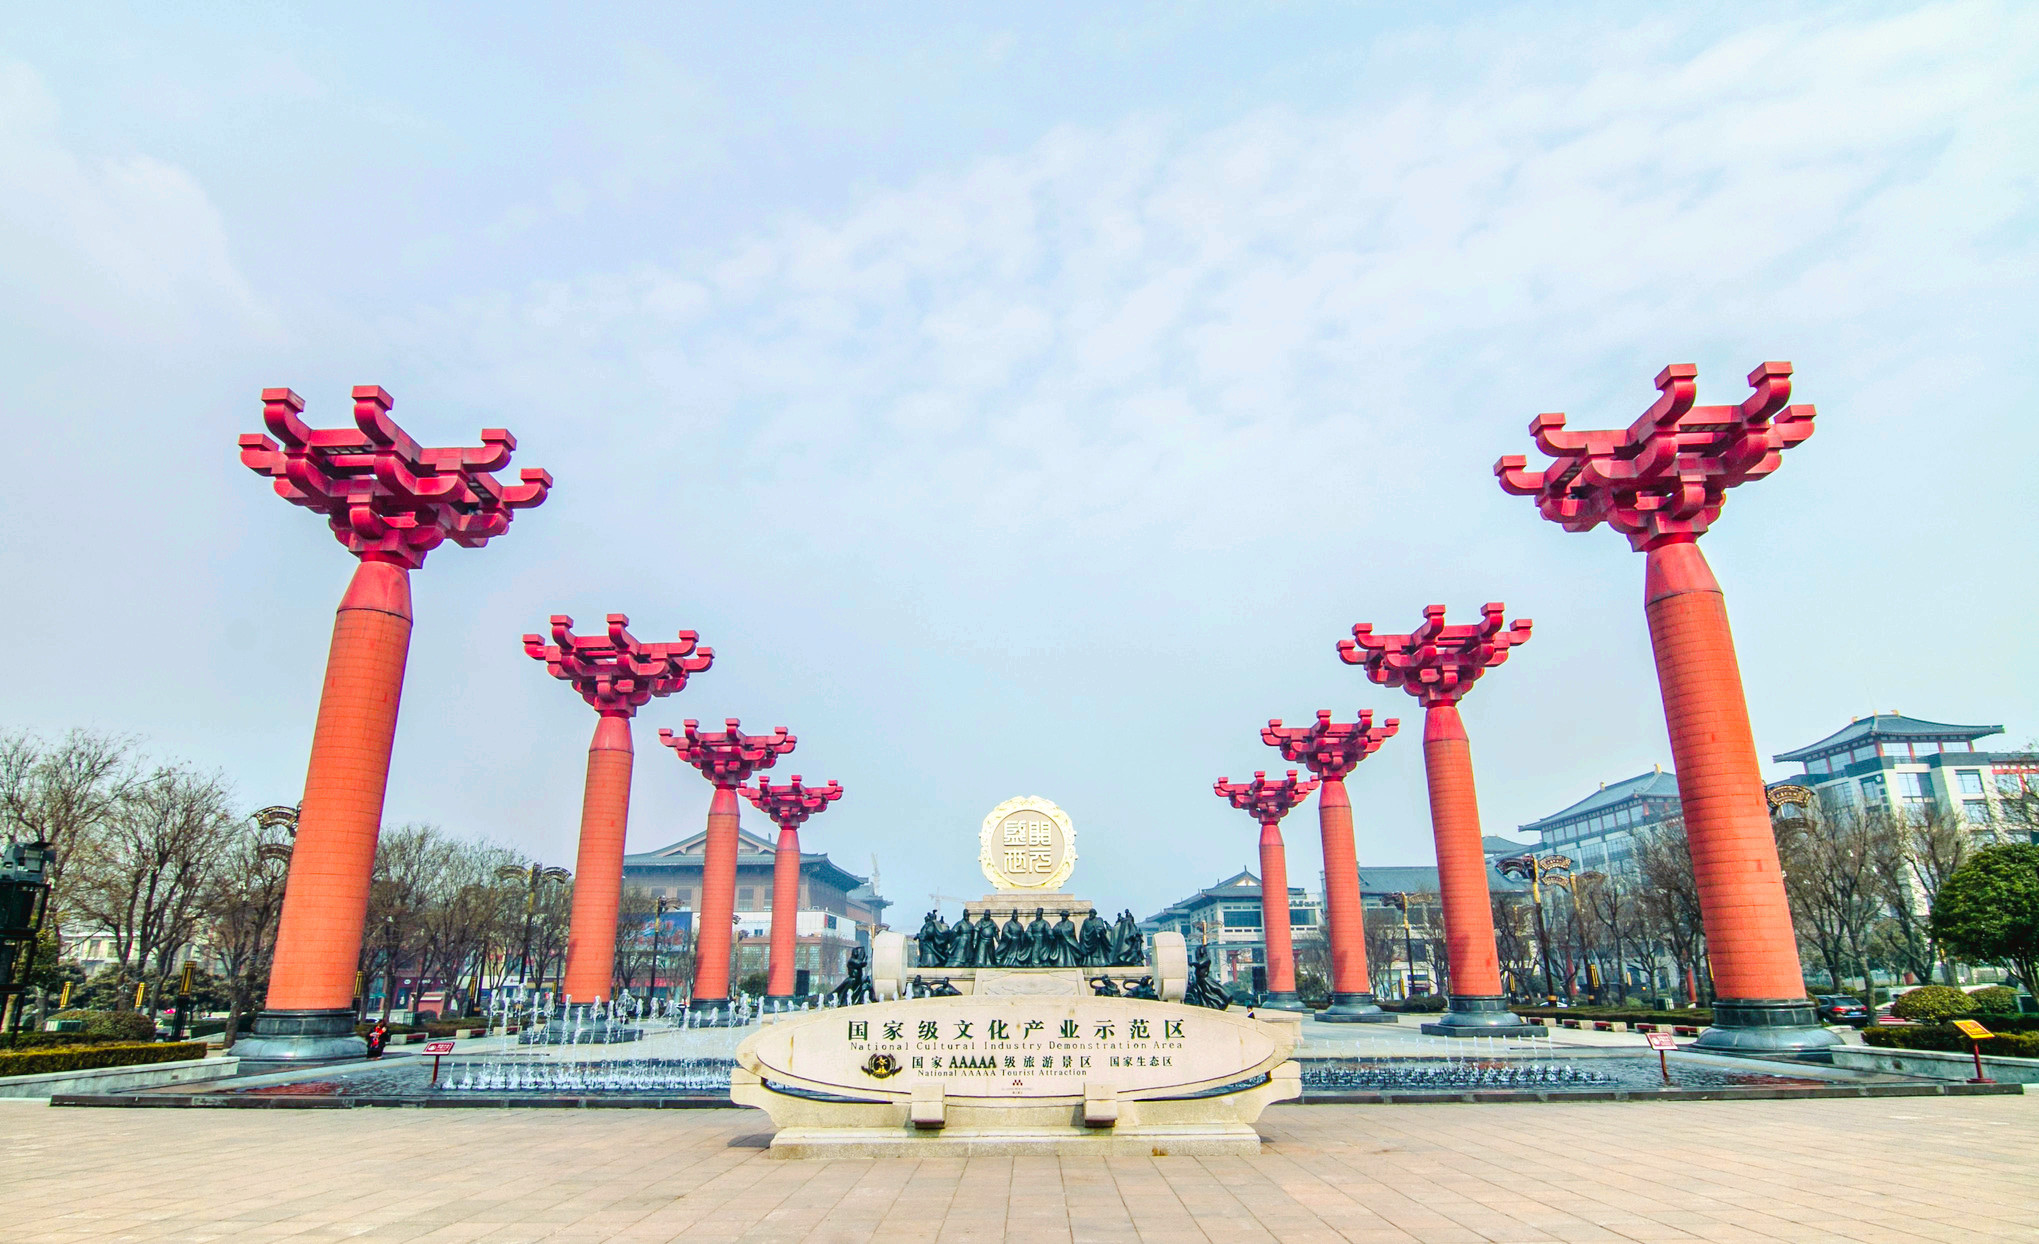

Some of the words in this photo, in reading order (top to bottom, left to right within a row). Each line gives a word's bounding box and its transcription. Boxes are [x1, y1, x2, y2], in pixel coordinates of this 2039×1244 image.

[848, 1019, 1186, 1041] 国家级文化产业示范区
[850, 1042, 909, 1051] National
[916, 1042, 975, 1051] Cultural
[984, 1041, 1042, 1051] Industry
[1049, 1040, 1147, 1050] Demonstration
[1153, 1040, 1183, 1050] Area
[1109, 1055, 1173, 1068] 国家生态区
[918, 1069, 957, 1077] National
[961, 1069, 996, 1077] AAAAA
[1001, 1069, 1035, 1077] Tourist
[1038, 1068, 1087, 1077] Attraction
